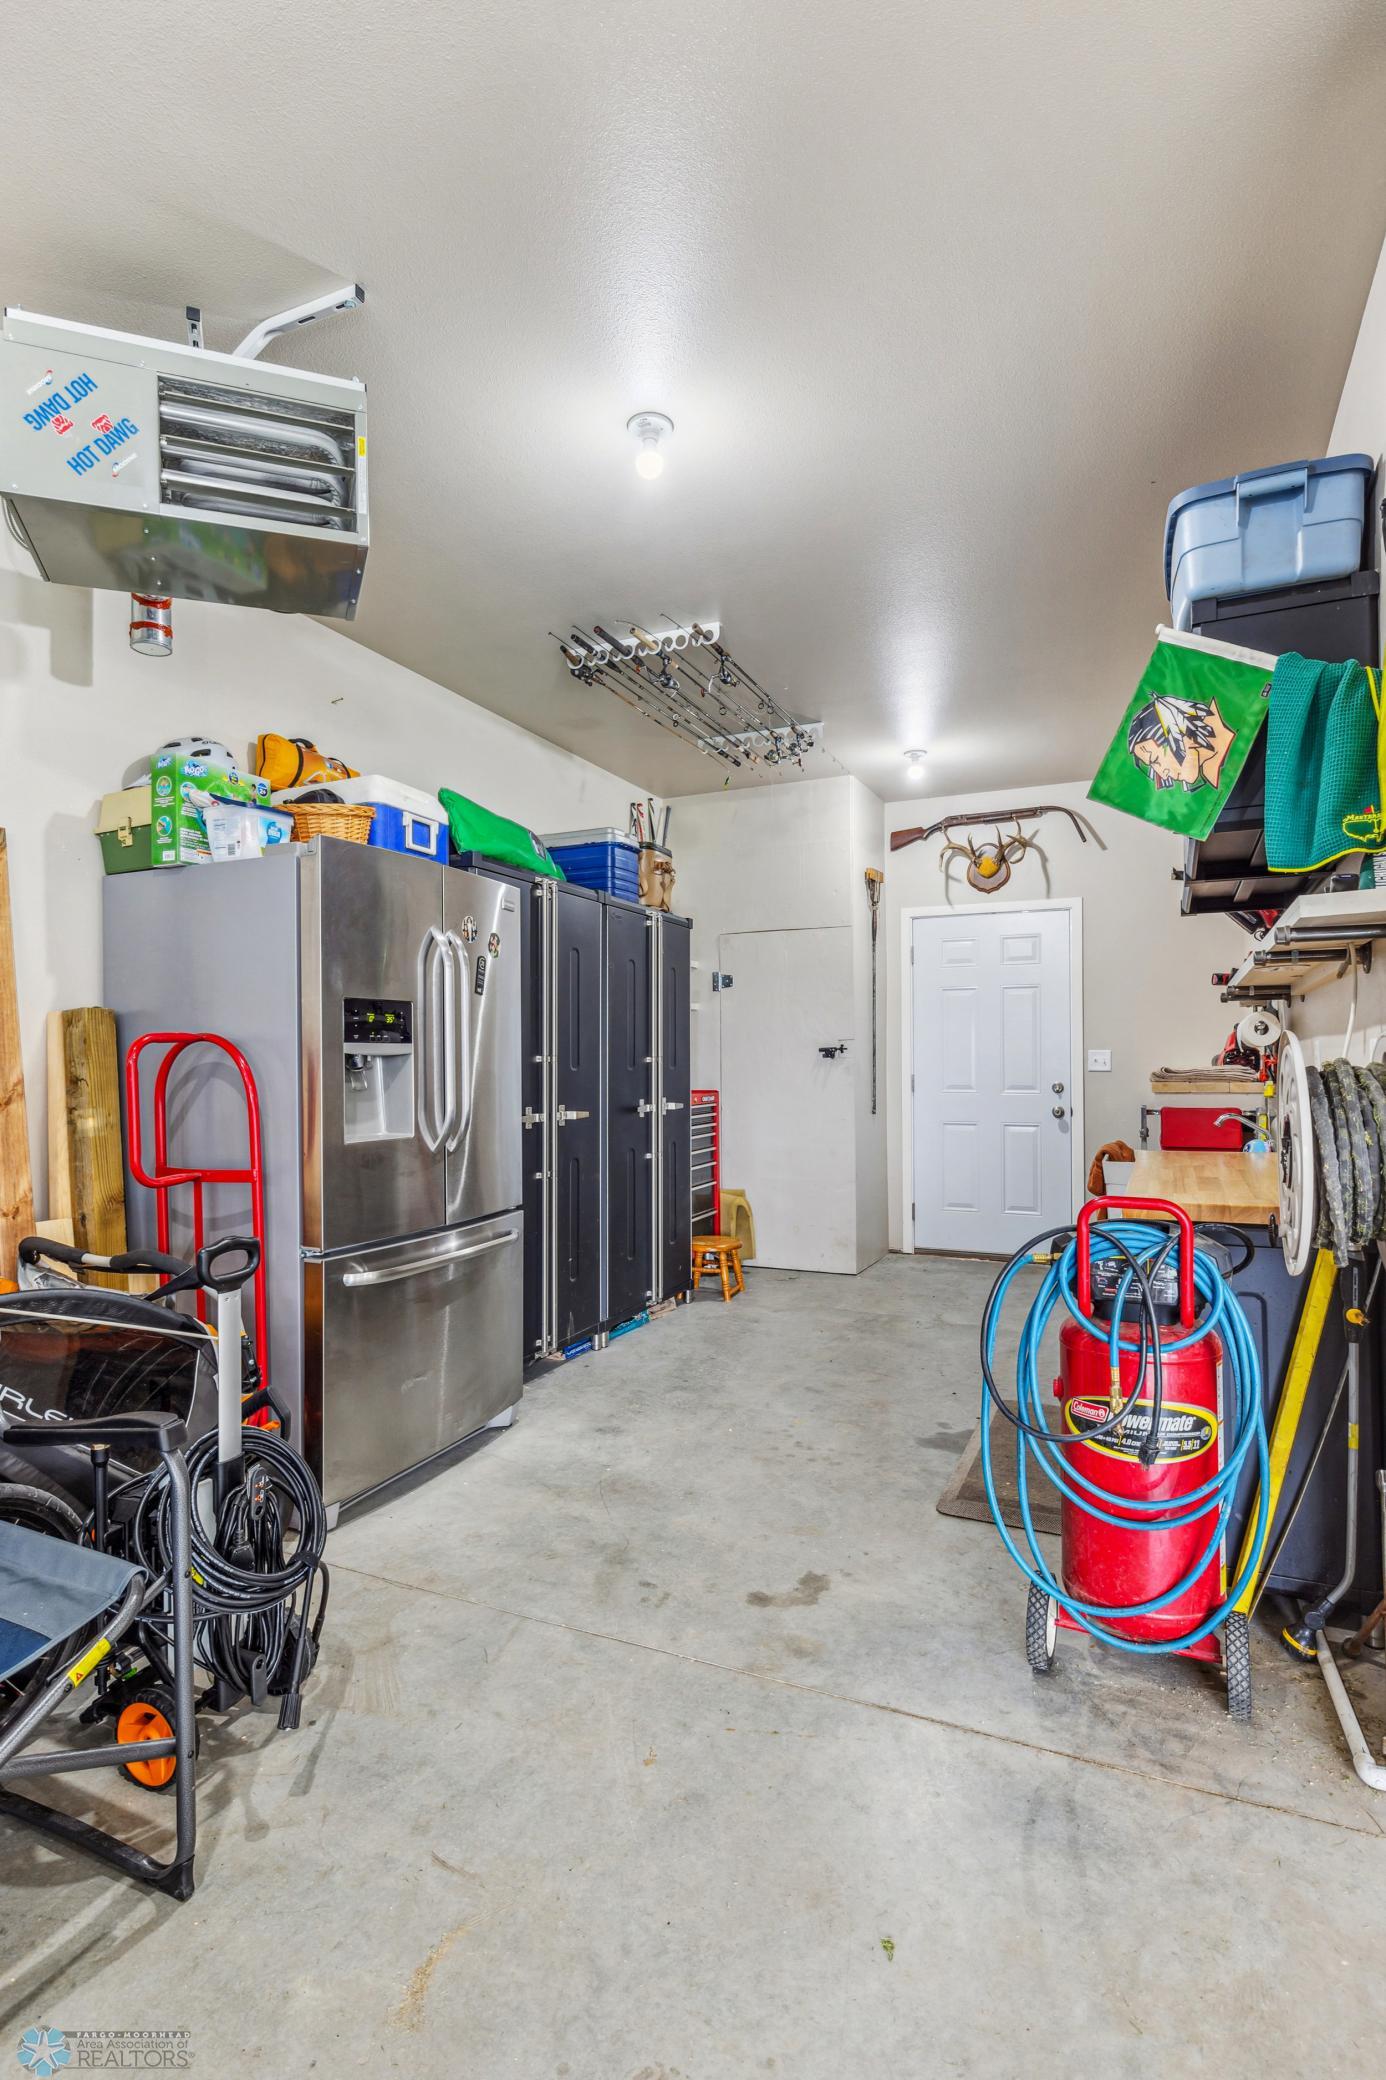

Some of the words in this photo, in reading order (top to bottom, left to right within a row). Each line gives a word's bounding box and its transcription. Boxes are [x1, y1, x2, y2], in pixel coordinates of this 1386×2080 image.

[64, 372, 98, 404] HOT
[22, 392, 71, 432] DAWG
[66, 445, 101, 476] HOT
[94, 417, 140, 456] DAWG
[1073, 1402, 1098, 1418] Coleman
[1107, 1411, 1194, 1432] wemate
